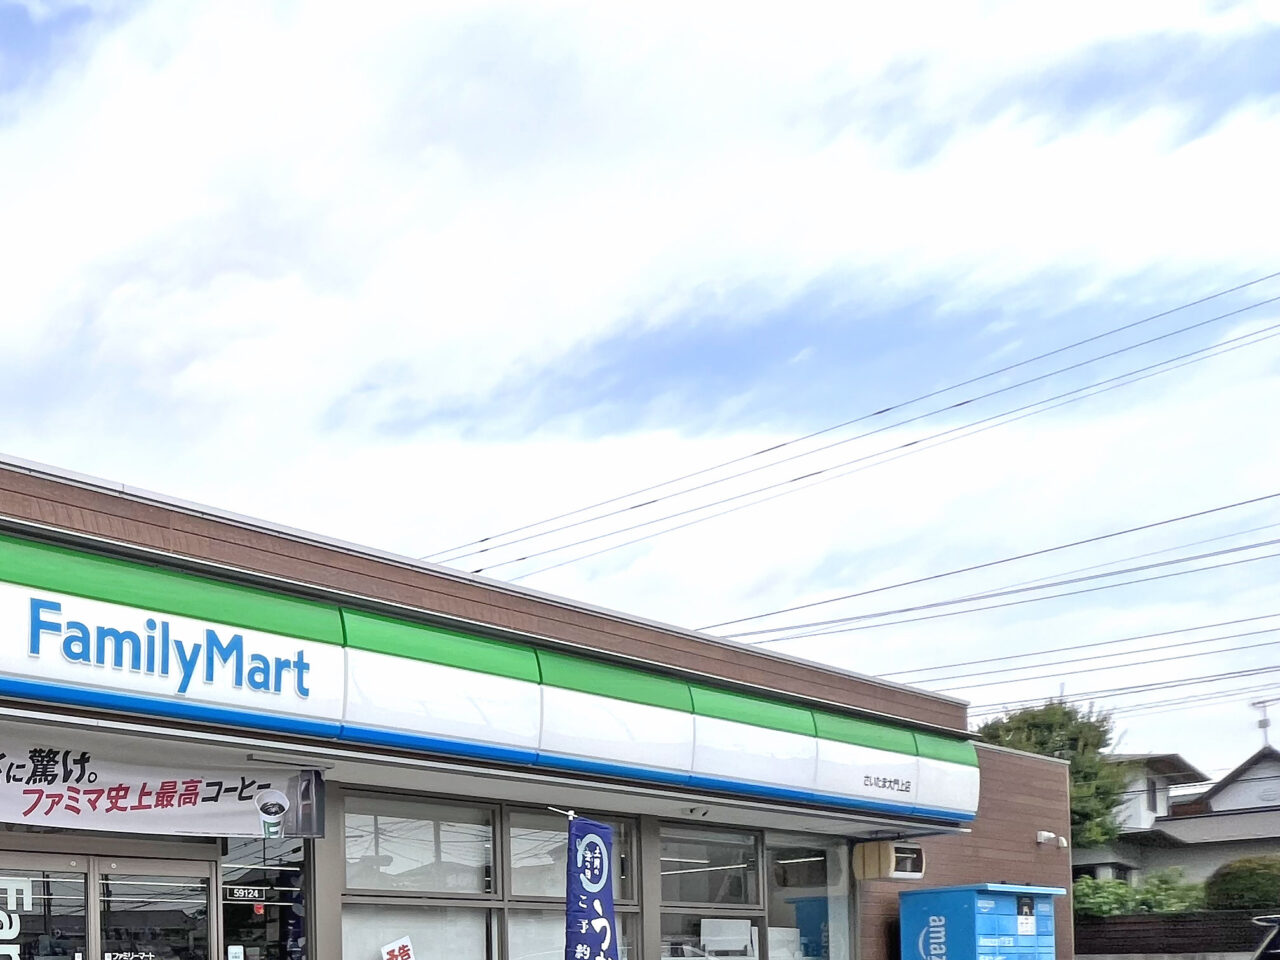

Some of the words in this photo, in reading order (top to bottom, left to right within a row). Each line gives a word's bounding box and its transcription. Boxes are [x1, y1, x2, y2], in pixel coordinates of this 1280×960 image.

[28, 597, 310, 698] FamilyMart
[863, 775, 912, 793] さいたま大門上店
[22, 776, 271, 818] ファミマ史上最高コーヒー
[233, 888, 259, 898] 59124
[112, 952, 155, 960] ファミリーマート
